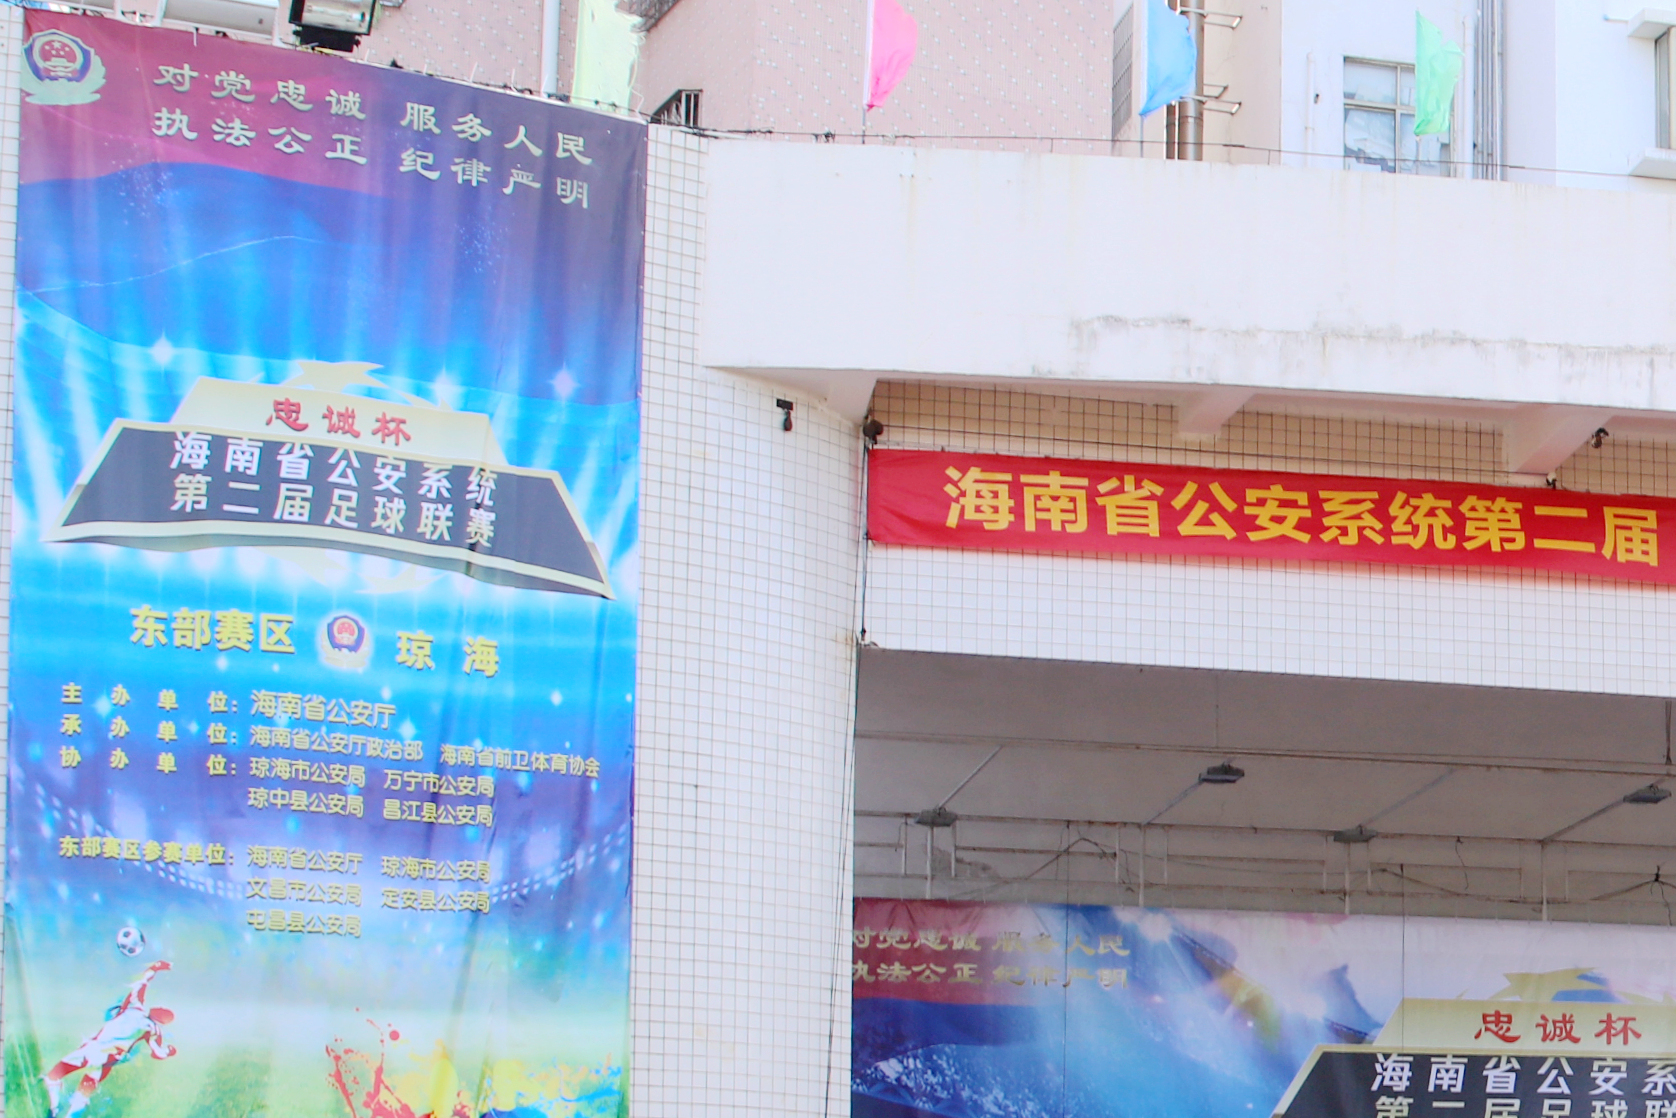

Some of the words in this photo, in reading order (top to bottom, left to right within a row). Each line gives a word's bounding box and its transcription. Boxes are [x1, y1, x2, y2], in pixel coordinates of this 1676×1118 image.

[153, 63, 366, 121] 对党忠诚
[399, 102, 594, 166] 服务人民
[152, 107, 369, 166] 执法公正
[399, 148, 592, 209] 纪律严明
[265, 397, 413, 446] 忠诚杯
[168, 430, 499, 508] 海南省公安系统
[169, 472, 497, 549] 第二届足球联赛
[129, 605, 297, 655] 东部赛区
[396, 630, 501, 677] 琼海
[250, 688, 397, 730] 海南省公安厅
[249, 724, 424, 762] 海南省公安厅政治部
[439, 742, 601, 779] 海南省前卫体育协会
[249, 755, 367, 790] 琼海市公安局
[383, 768, 496, 799] 万宁市公安局
[246, 786, 365, 819] 琼中县公安局
[381, 797, 494, 829] 昌江县公安局
[246, 844, 364, 876] 海南省公安厅
[380, 854, 492, 884] 琼海市公安局
[245, 876, 363, 908] 文昌市公安局
[380, 886, 491, 915] 定安县公安局
[245, 908, 363, 938] 屯昌县公安局
[991, 929, 1131, 956] 服务人民
[991, 963, 1129, 989] 纪律严明
[1473, 1009, 1643, 1046] 忠诚杯
